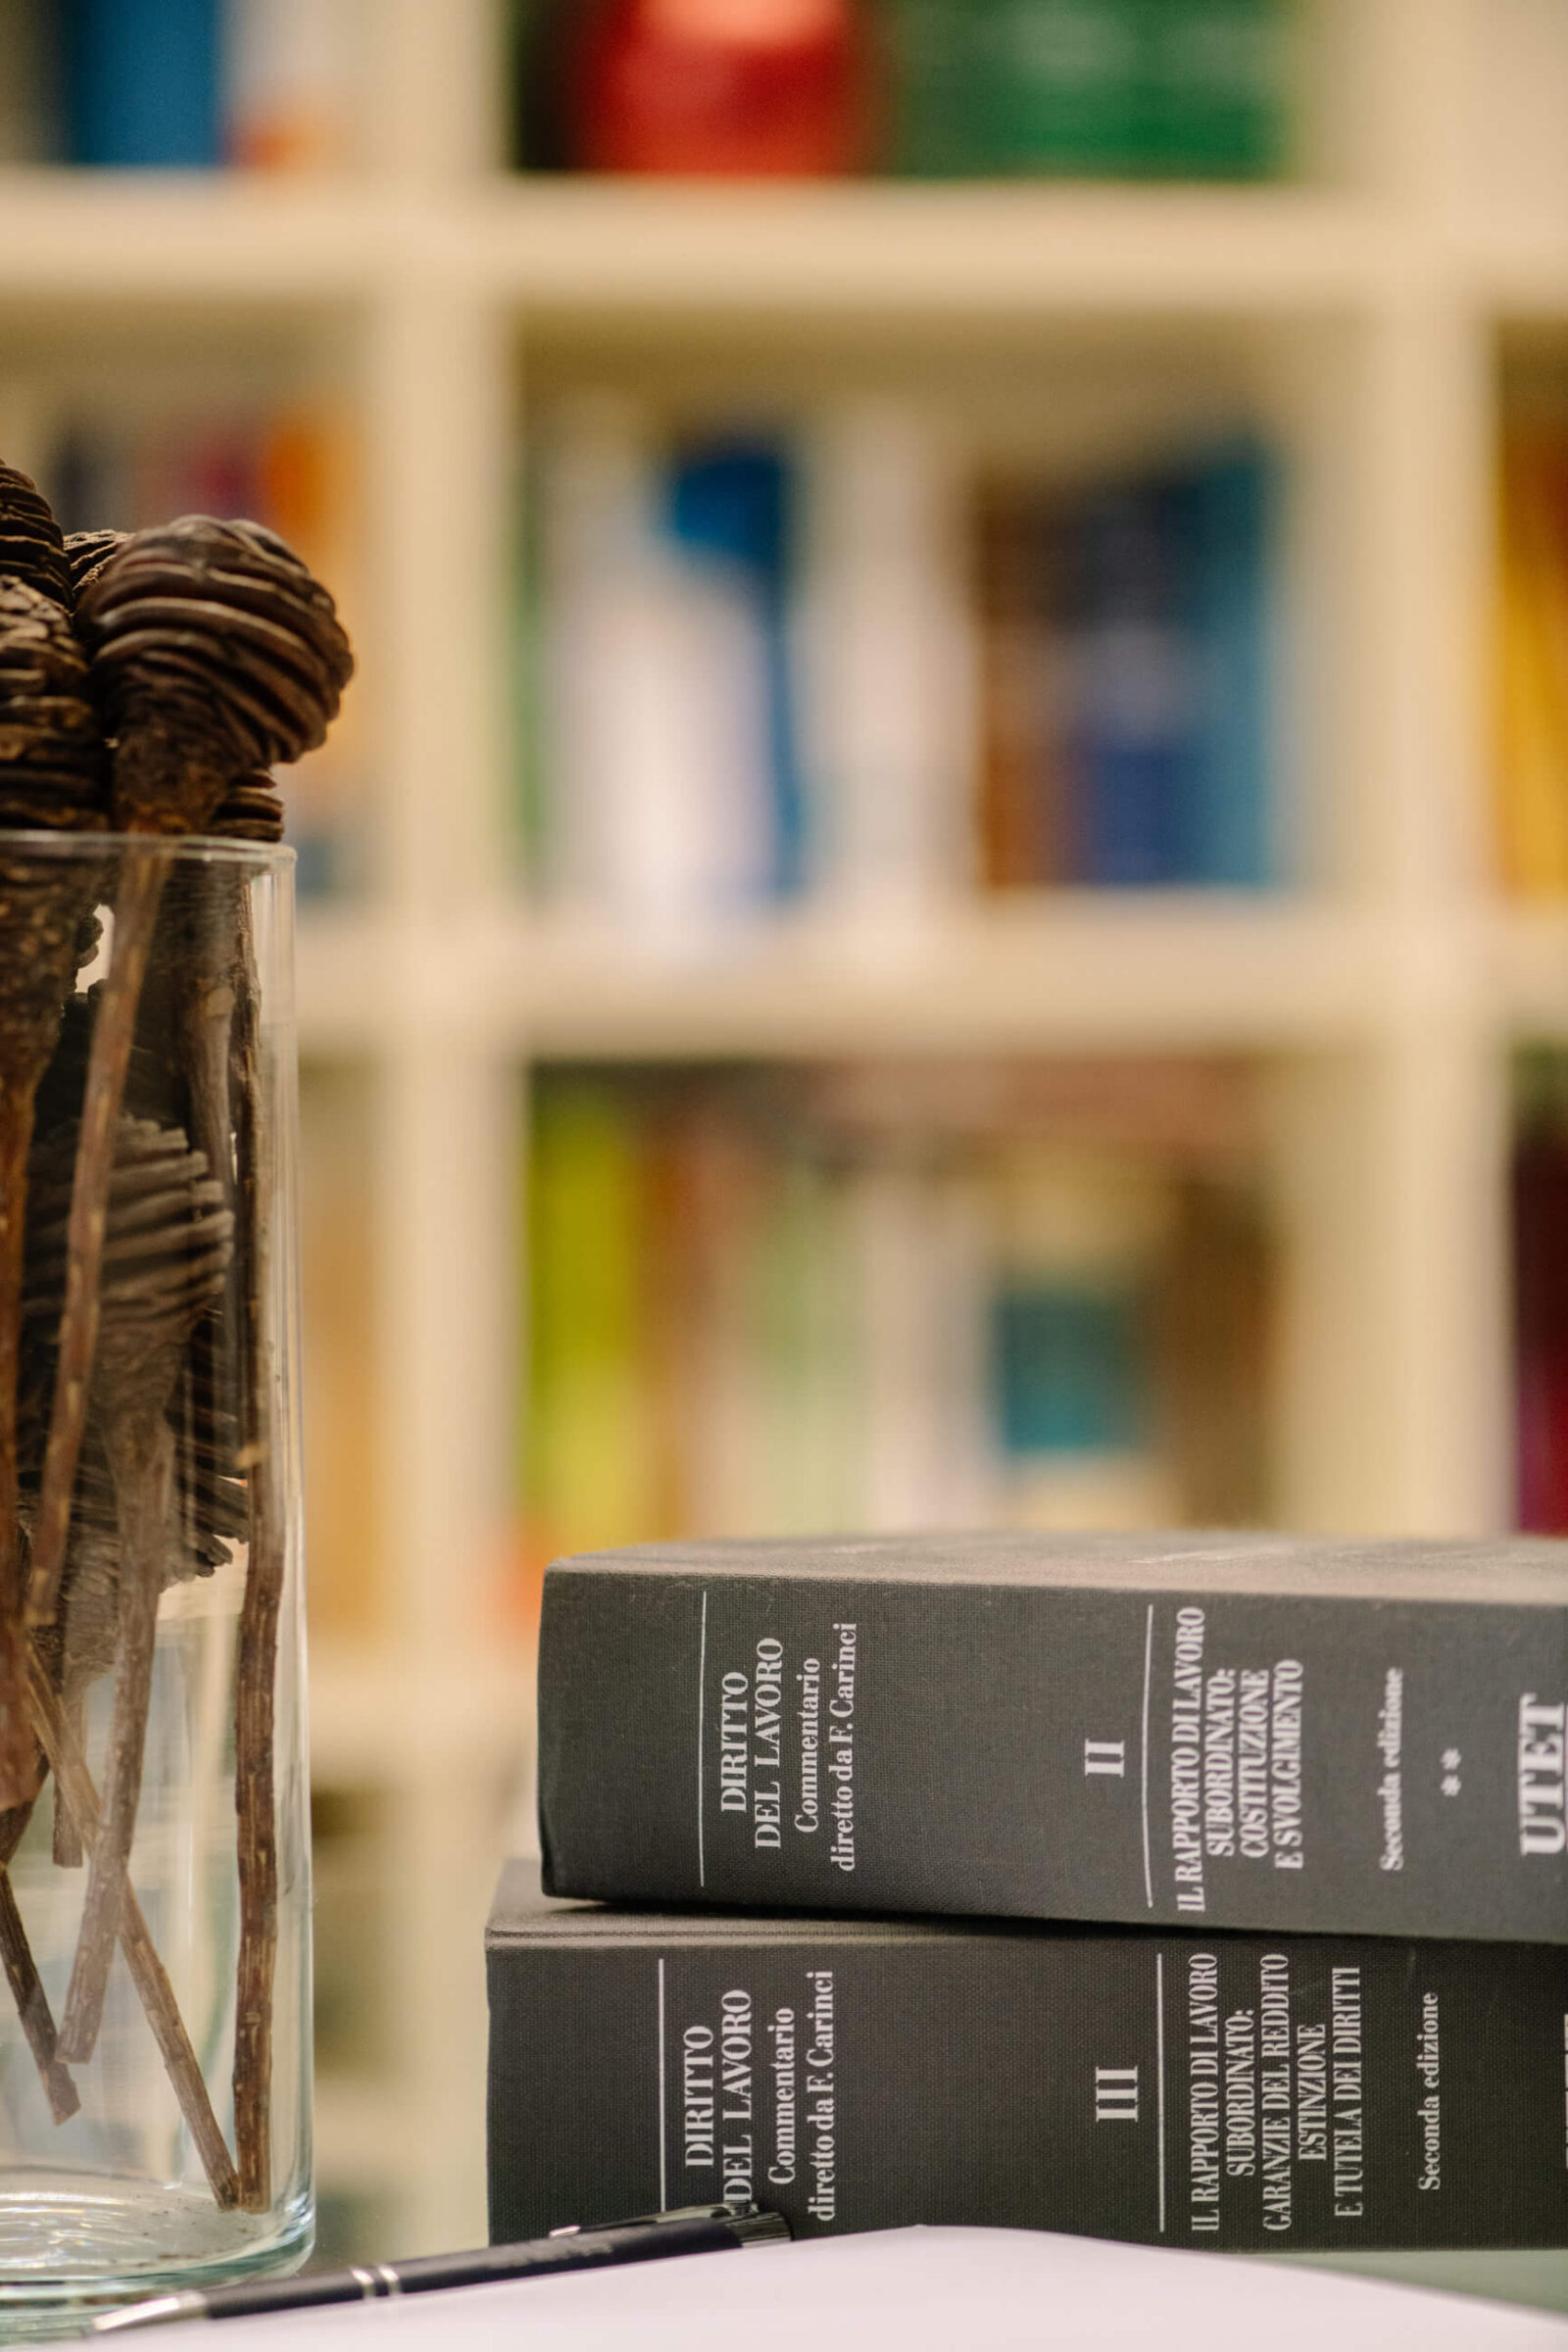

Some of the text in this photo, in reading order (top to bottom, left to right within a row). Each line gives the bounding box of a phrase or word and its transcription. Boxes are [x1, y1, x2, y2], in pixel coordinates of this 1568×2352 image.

[721, 1672, 748, 1812] DIRITTO
[755, 1638, 783, 1848] DEL LAVORO
[794, 1658, 820, 1833] Commentario
[829, 1623, 857, 1871] diretto da F. Carinci
[1085, 1739, 1124, 1778] II
[1171, 1607, 1205, 1912] IL RAPPORTO DI LAVORO
[1204, 1668, 1236, 1856] SUBORDINATO:
[1238, 1669, 1269, 1858] COSTITUZIONE
[1271, 1659, 1304, 1869] E SVOLGIMENTO
[1377, 1667, 1403, 1870] Seconda edizione
[1518, 1692, 1565, 1857] UTET
[683, 2026, 713, 2166] DIRITTO
[721, 1989, 752, 2205] DEL LAVORO
[767, 2008, 796, 2184] Commentario
[806, 1971, 835, 2221] diretto da F. Carinci
[1096, 2066, 1138, 2122] III
[1188, 1953, 1219, 2230] IL RAPPORTO DI LAVORO
[1225, 2009, 1254, 2177] SUBORDINATO:
[1260, 1954, 1292, 2230] GARANZIE DEL REDDITO
[1298, 2024, 1327, 2161] ESTINZIONE
[1332, 1967, 1363, 2216] E TUTELA DEI DIRITTI
[1416, 1991, 1440, 2190] Seconda edizione
